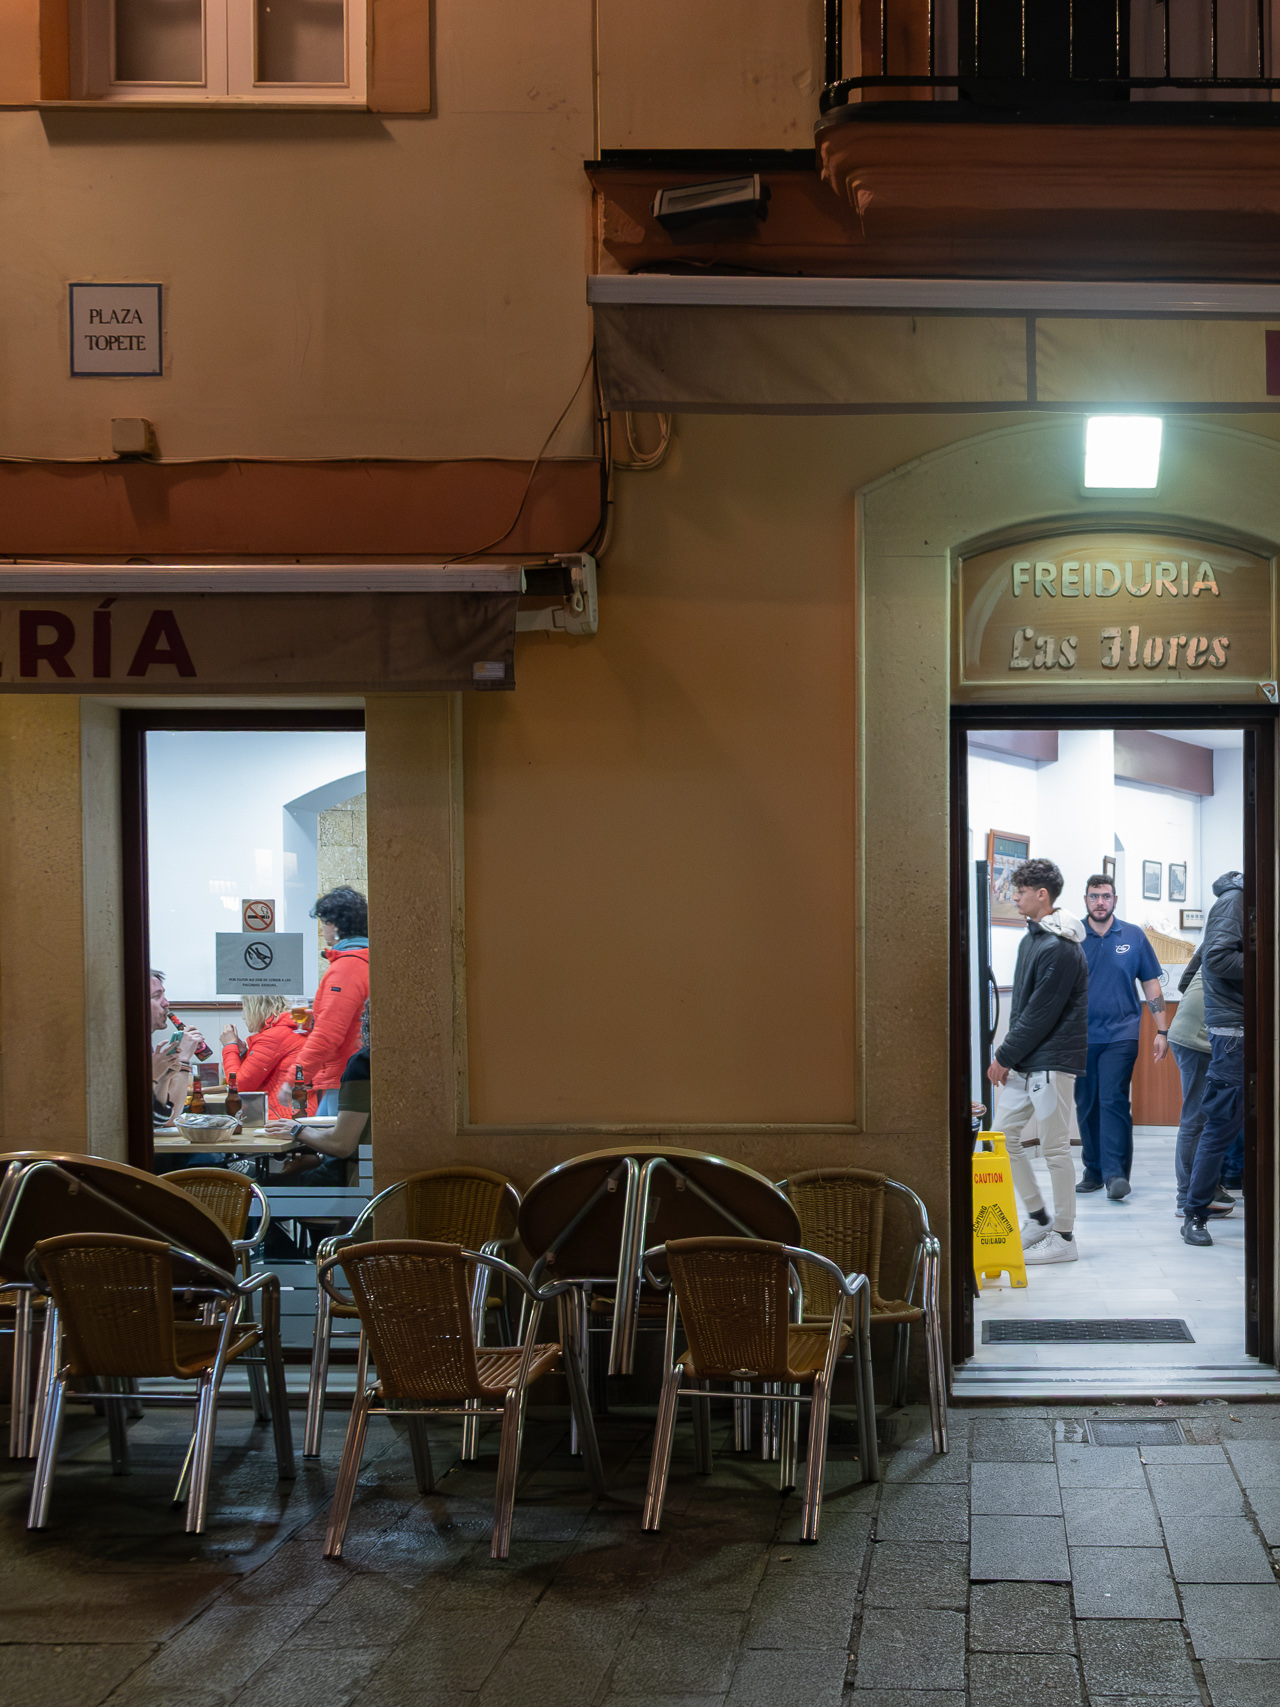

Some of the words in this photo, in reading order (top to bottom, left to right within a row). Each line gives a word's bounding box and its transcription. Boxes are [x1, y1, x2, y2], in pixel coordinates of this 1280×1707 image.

[89, 308, 143, 324] PLAZA
[84, 334, 146, 350] TOPETE
[1012, 560, 1220, 597] FREIDURIA
[0, 597, 197, 678] RÍA
[1009, 625, 1079, 671] Las
[1101, 625, 1230, 670] Flores
[974, 1172, 1003, 1184] CAUTION
[973, 1205, 988, 1232] ACHTUNG
[992, 1203, 1014, 1233] ATTENTION
